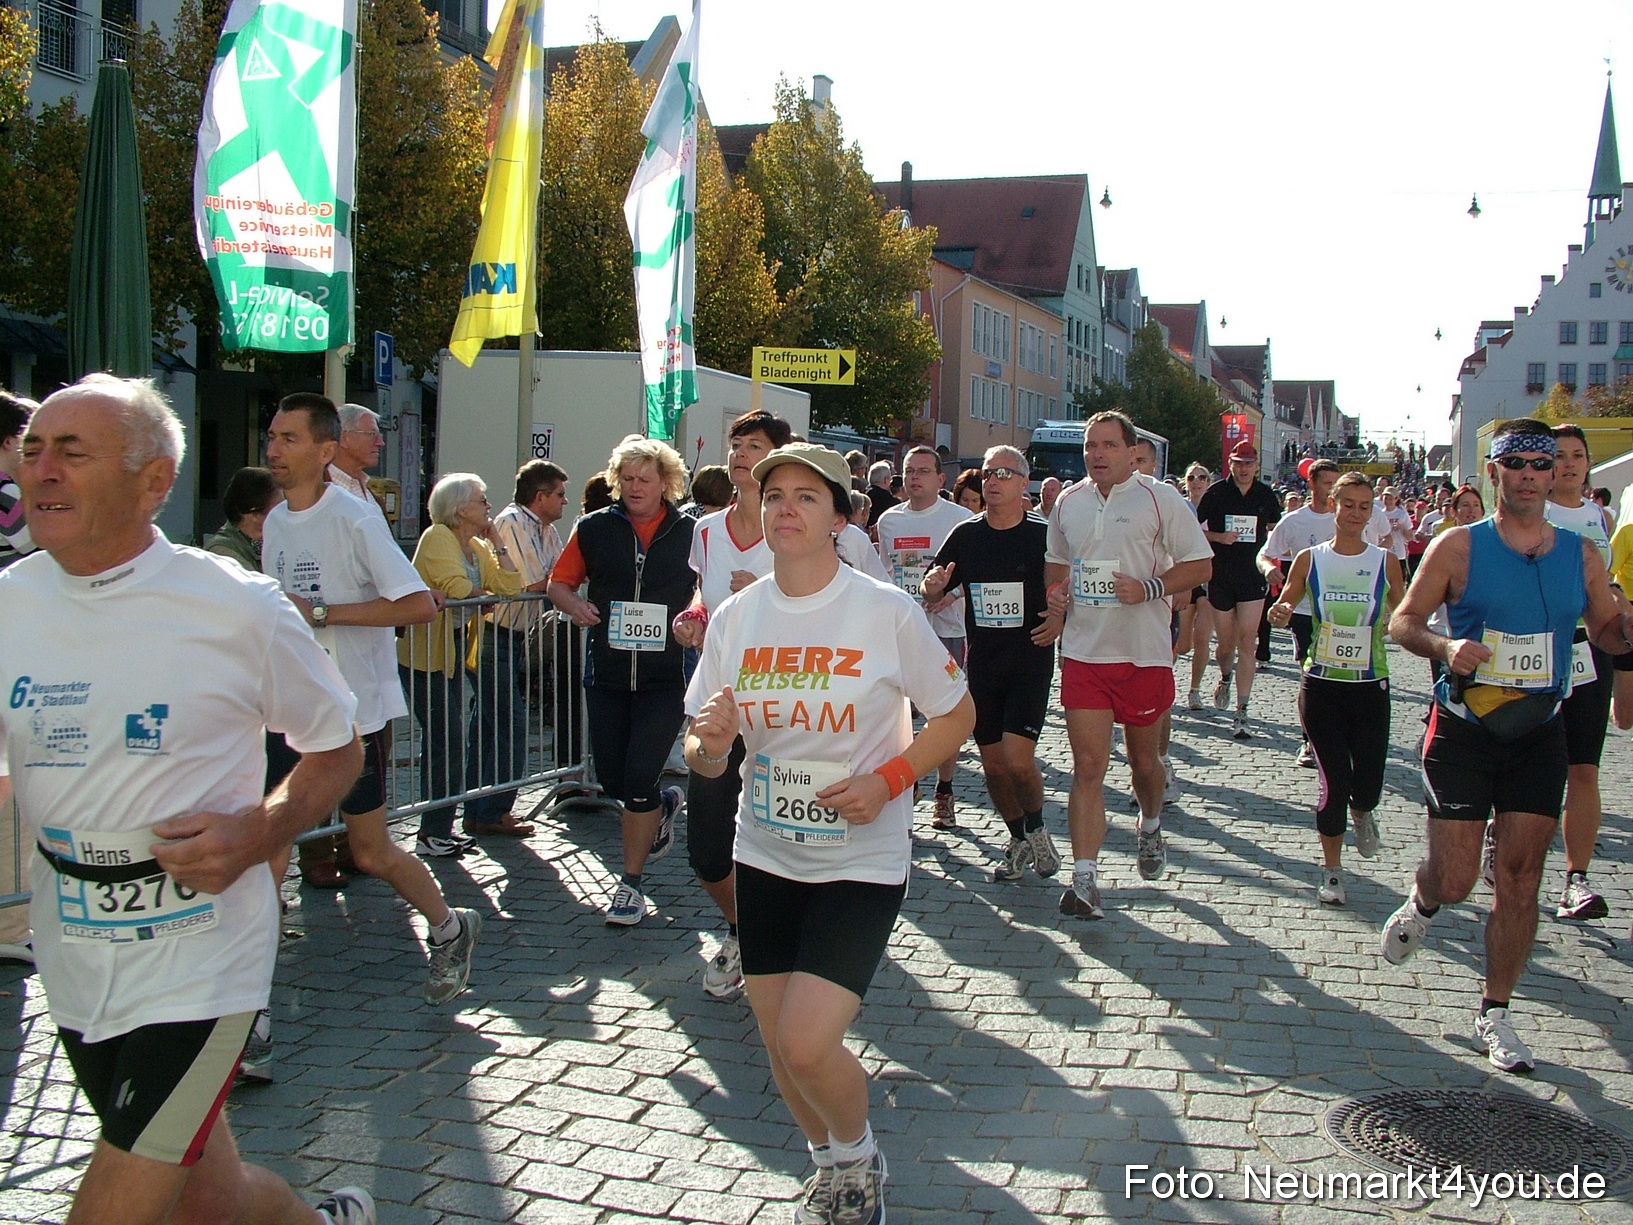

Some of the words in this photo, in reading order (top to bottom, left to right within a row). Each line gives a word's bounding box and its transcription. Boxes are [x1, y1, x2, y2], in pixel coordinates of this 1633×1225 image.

[379, 340, 389, 377] P
[761, 350, 828, 365] Treffpunkt
[760, 366, 831, 381] Bladenight
[983, 587, 1002, 596] Peter
[1083, 580, 1115, 594] 3139
[1323, 591, 1371, 603] BOCK
[624, 606, 644, 617] Luise
[986, 602, 1020, 615] 3138
[625, 623, 662, 638] 3050
[1332, 628, 1356, 640] Sabine
[1502, 633, 1535, 645] Helmut
[1336, 644, 1363, 658] 687
[741, 646, 864, 678] MERZ
[1508, 654, 1543, 671] 106
[734, 665, 831, 692] Reisen
[9, 675, 36, 709] 6.
[30, 681, 92, 695] Neumarkter
[41, 693, 90, 707] Stadtlauf
[738, 700, 856, 733] TEAM
[128, 738, 159, 749] DKMS
[773, 765, 811, 786] Sylvia
[776, 796, 839, 824] 2669
[805, 833, 846, 842] PFLEIDERER
[81, 841, 131, 864] Hans
[63, 924, 117, 939] BOCK
[154, 911, 217, 935] PFLEIDERER
